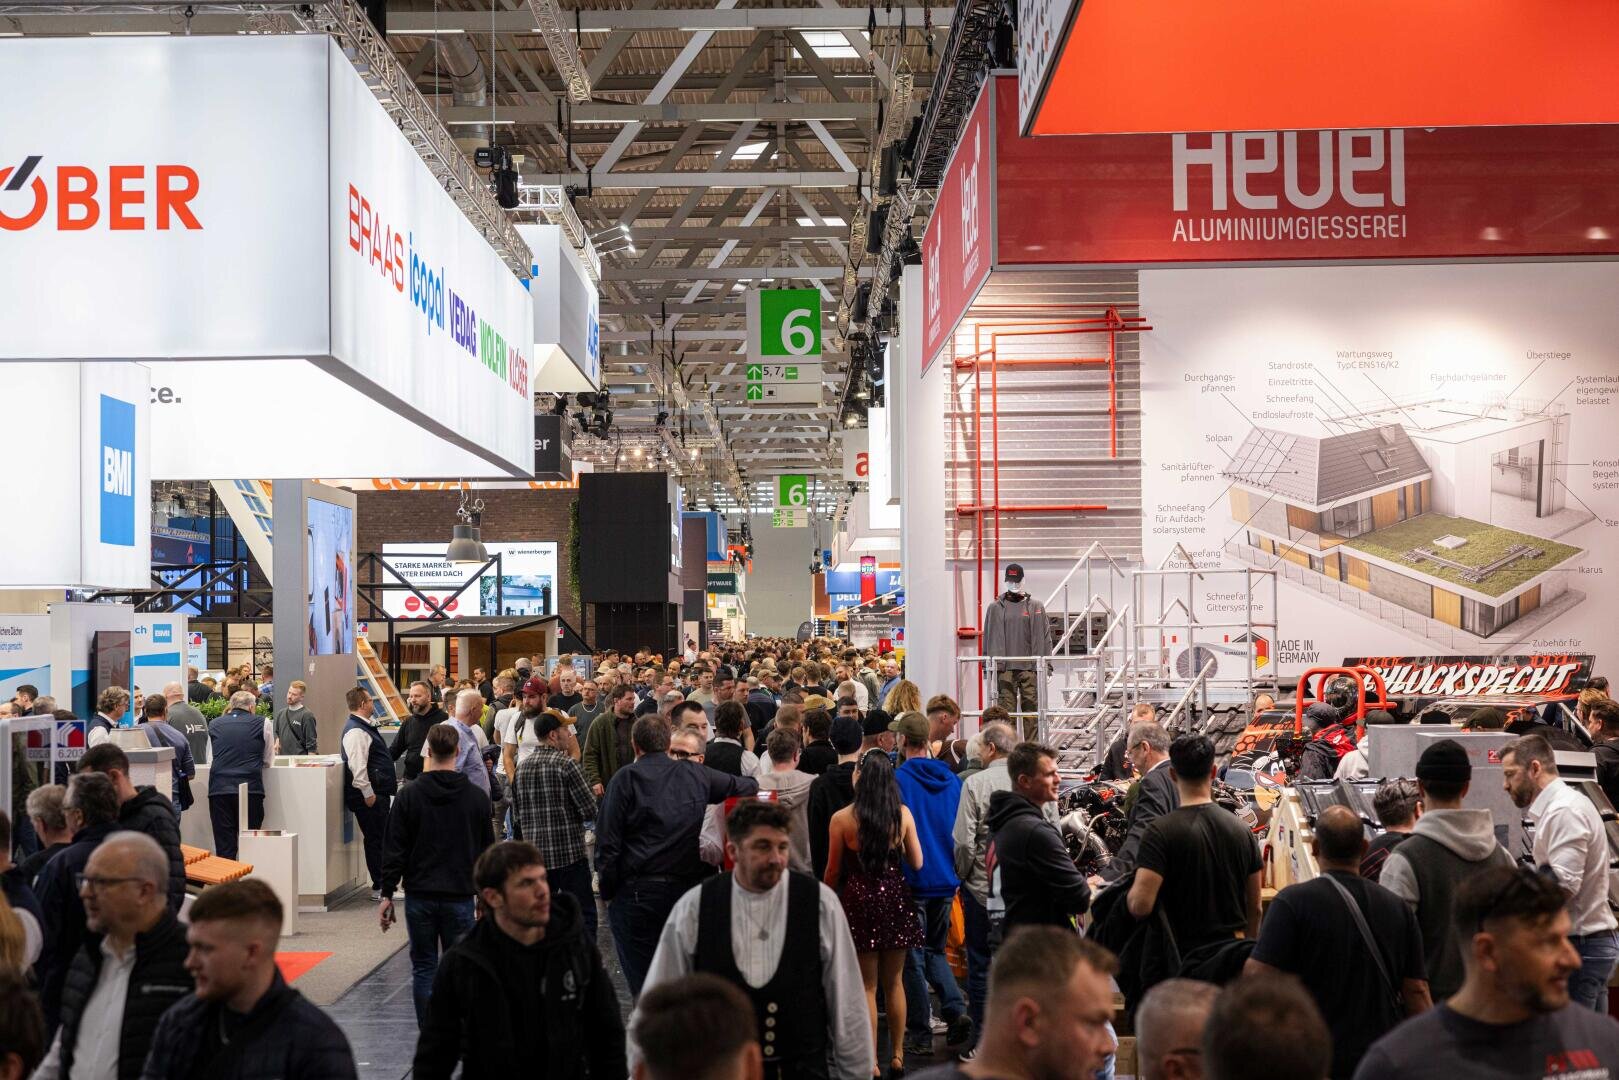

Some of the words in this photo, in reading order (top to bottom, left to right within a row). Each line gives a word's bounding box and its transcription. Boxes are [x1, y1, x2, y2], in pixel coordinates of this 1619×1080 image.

[1172, 214, 1407, 242] ALUMINIUMGIESSEREI
[349, 182, 404, 293] BRAAS
[409, 232, 445, 336] icopal
[449, 288, 477, 357] VEDAG
[480, 318, 507, 382] WOLFIN
[780, 308, 815, 356] 6
[1336, 350, 1393, 359] Wartungsweg
[1526, 350, 1572, 360] Überstiege
[1268, 361, 1314, 370] Standroste
[1337, 361, 1356, 370] TypC
[1184, 373, 1236, 383] Durchgangs-
[1268, 378, 1314, 387] Einzeltritte
[1430, 373, 1507, 383] Flachdachgeländer
[1201, 384, 1236, 394] pfannen
[1266, 395, 1314, 404] Schneefang
[1576, 397, 1610, 405] belastet
[1252, 411, 1314, 419] Endloslaufroste
[1205, 434, 1233, 444] Solpan
[104, 445, 132, 497] BMI
[1161, 462, 1215, 471] Sanitärlüfter-
[1181, 474, 1215, 482] pfannen
[788, 484, 805, 506] 6
[1157, 504, 1206, 514] Schneefang
[1155, 515, 1168, 523] für
[1169, 515, 1206, 523] Aufdach-
[1152, 526, 1206, 535] solarsysteme
[1578, 566, 1603, 574] Ikarus
[154, 629, 171, 638] BMI
[1303, 639, 1314, 651] IN
[1532, 639, 1567, 647] Zubehör
[1569, 639, 1582, 647] für
